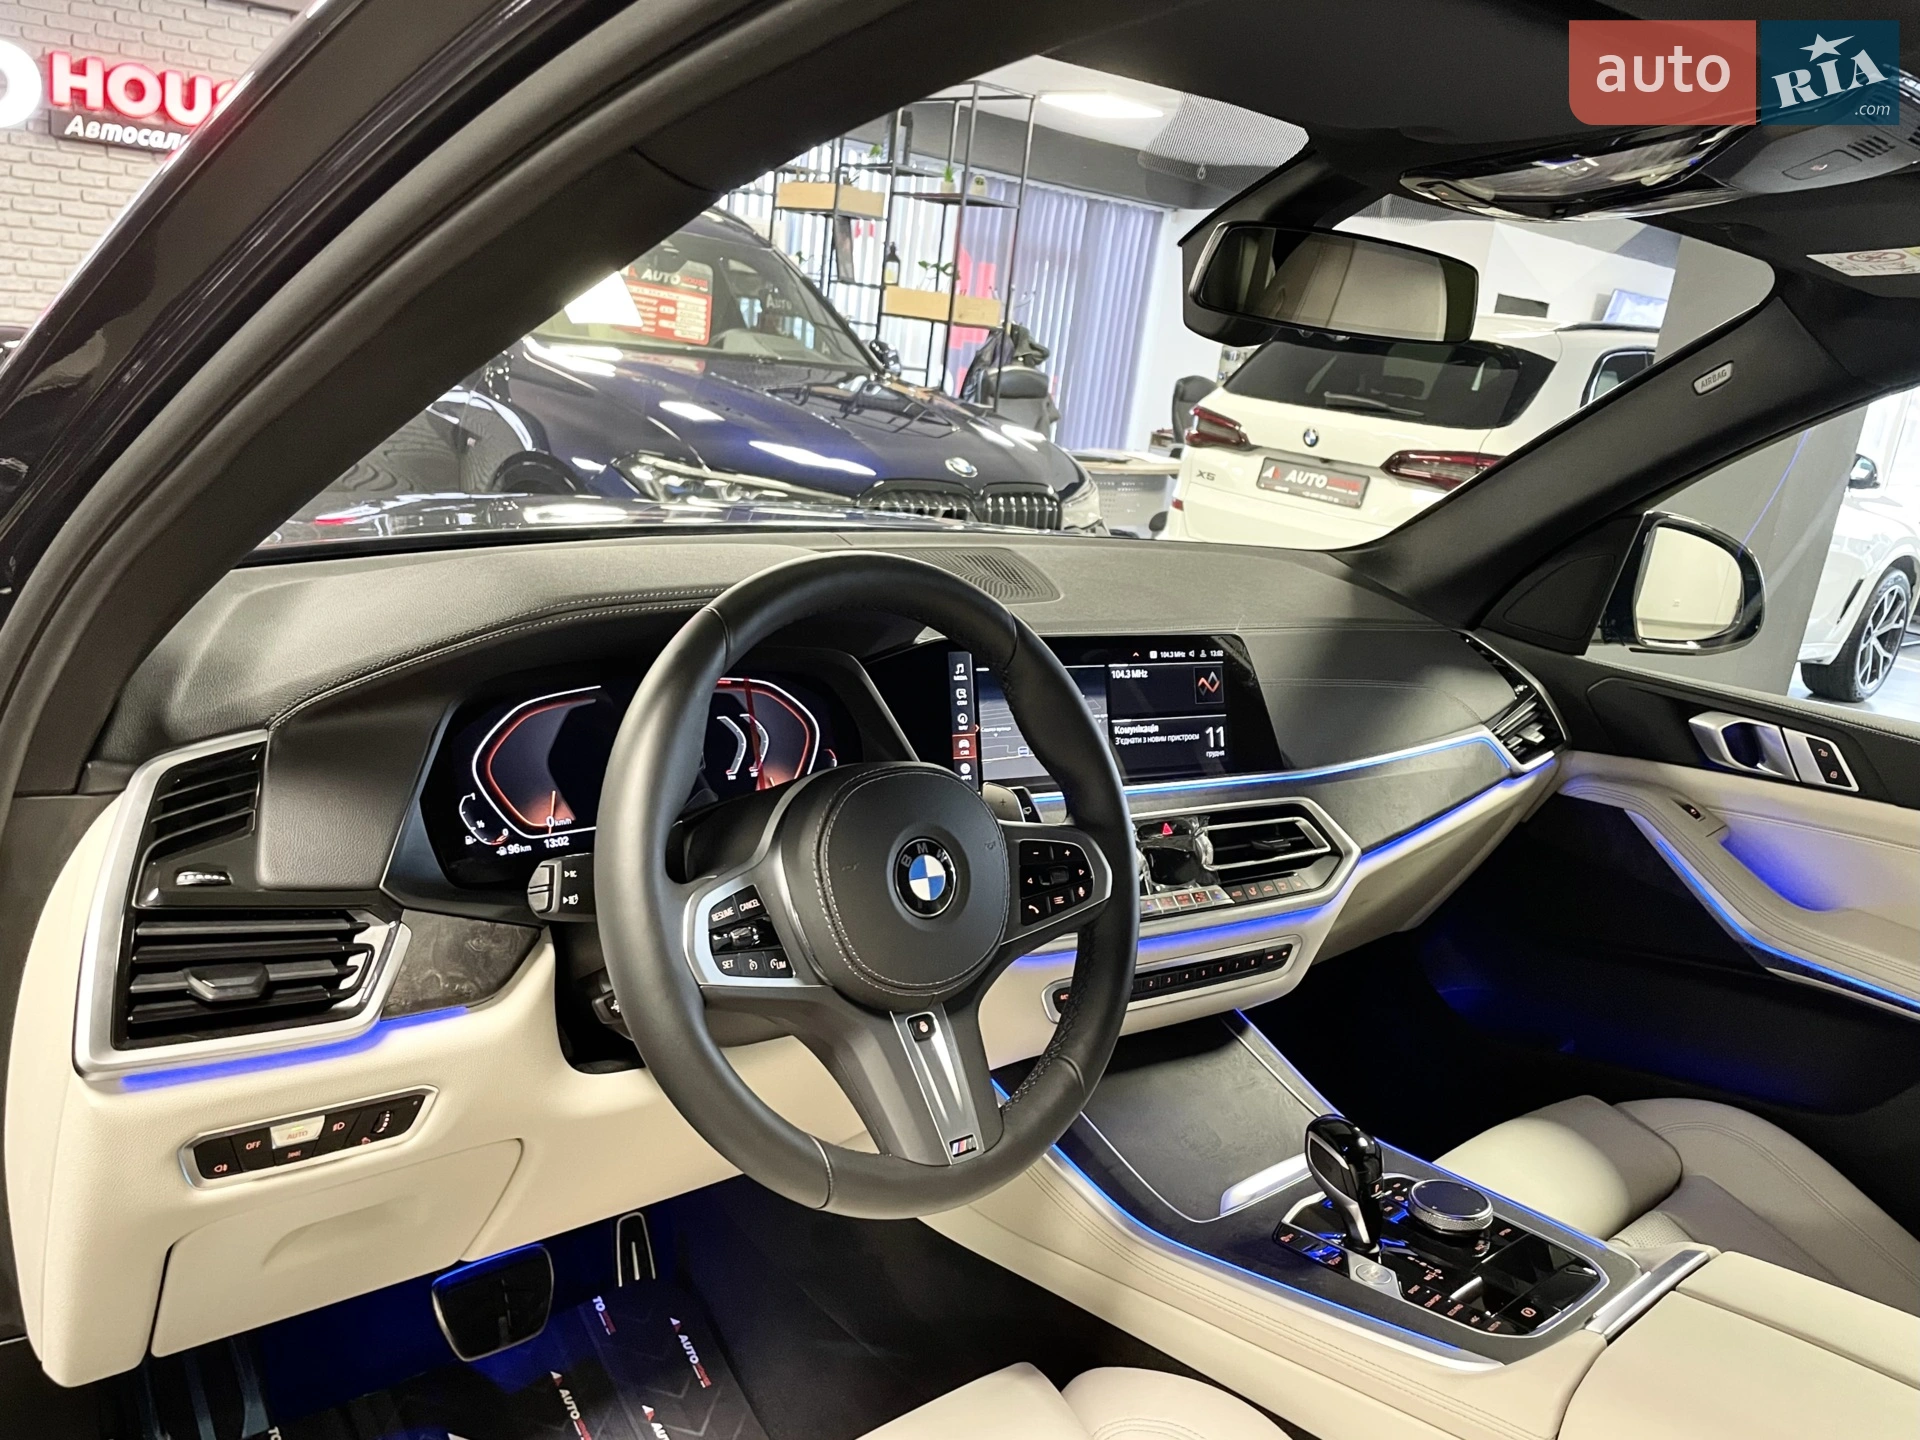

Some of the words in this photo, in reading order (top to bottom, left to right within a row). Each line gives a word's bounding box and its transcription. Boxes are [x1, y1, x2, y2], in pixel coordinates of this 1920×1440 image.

[49, 51, 237, 127] HOU
[641, 269, 681, 285] AUTO
[1700, 369, 1728, 389] AIRBAG
[1196, 470, 1217, 481] X5
[1285, 469, 1328, 489] AUTO
[1111, 670, 1132, 679] 104.3
[1131, 669, 1149, 678] MHz
[1205, 726, 1225, 748] 11
[546, 815, 555, 828] 0
[507, 843, 521, 855] 96
[520, 844, 532, 853] km
[544, 837, 570, 849] 13:02
[900, 842, 947, 868] BMW
[739, 898, 760, 912] CANCEL
[711, 906, 735, 922] RESUME
[722, 960, 734, 969] SET
[286, 1130, 309, 1141] AUTO
[246, 1140, 261, 1150] OFF
[678, 1334, 700, 1364] AUTO
[559, 1389, 581, 1420] AUTO
